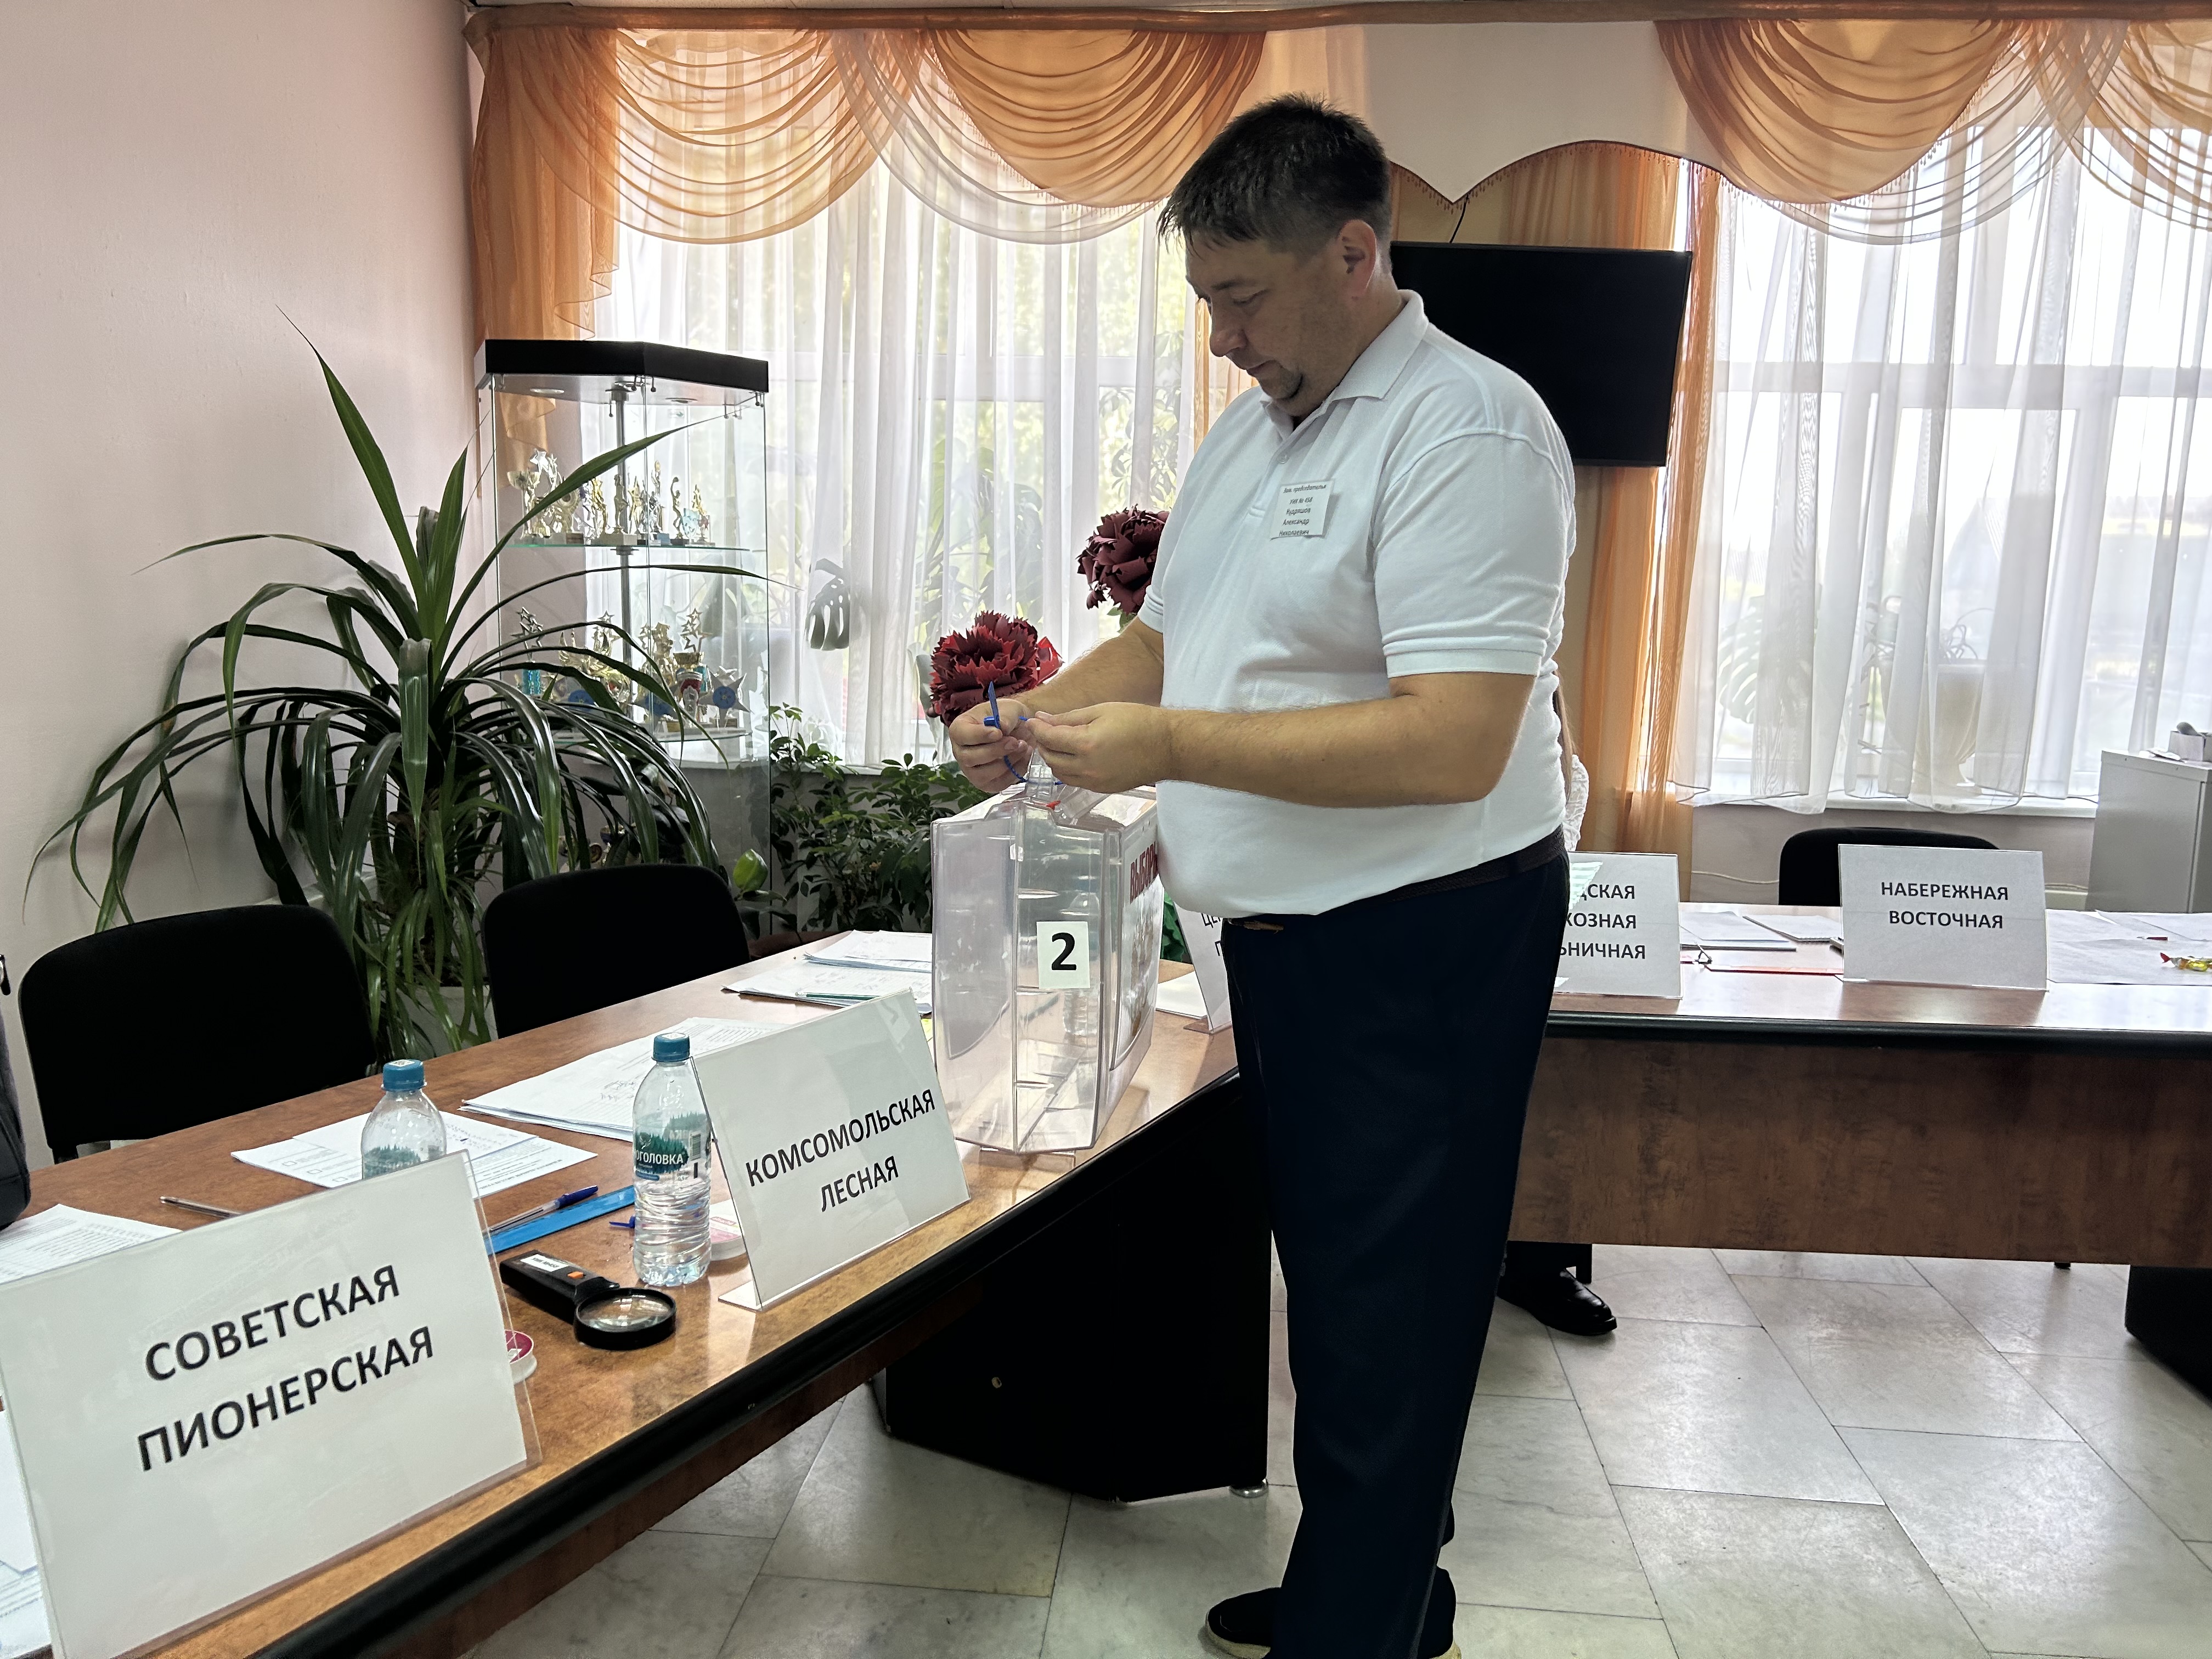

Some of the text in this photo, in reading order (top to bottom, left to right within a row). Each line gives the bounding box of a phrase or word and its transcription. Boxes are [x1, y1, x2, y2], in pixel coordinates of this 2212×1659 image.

[1881, 882, 2008, 900] НАБЕРЕЖНАЯ
[1889, 910, 2003, 929] ВОСТОЧНАЯ
[1052, 932, 1077, 970] 2
[746, 1089, 935, 1187] КОМСОМОЛЬСКАЯ
[821, 1155, 899, 1212] ЛЕСНАЯ
[145, 1265, 399, 1381] СОВЕТСКАЯ
[137, 1325, 433, 1471] ПИОНЕРСКАЯ
